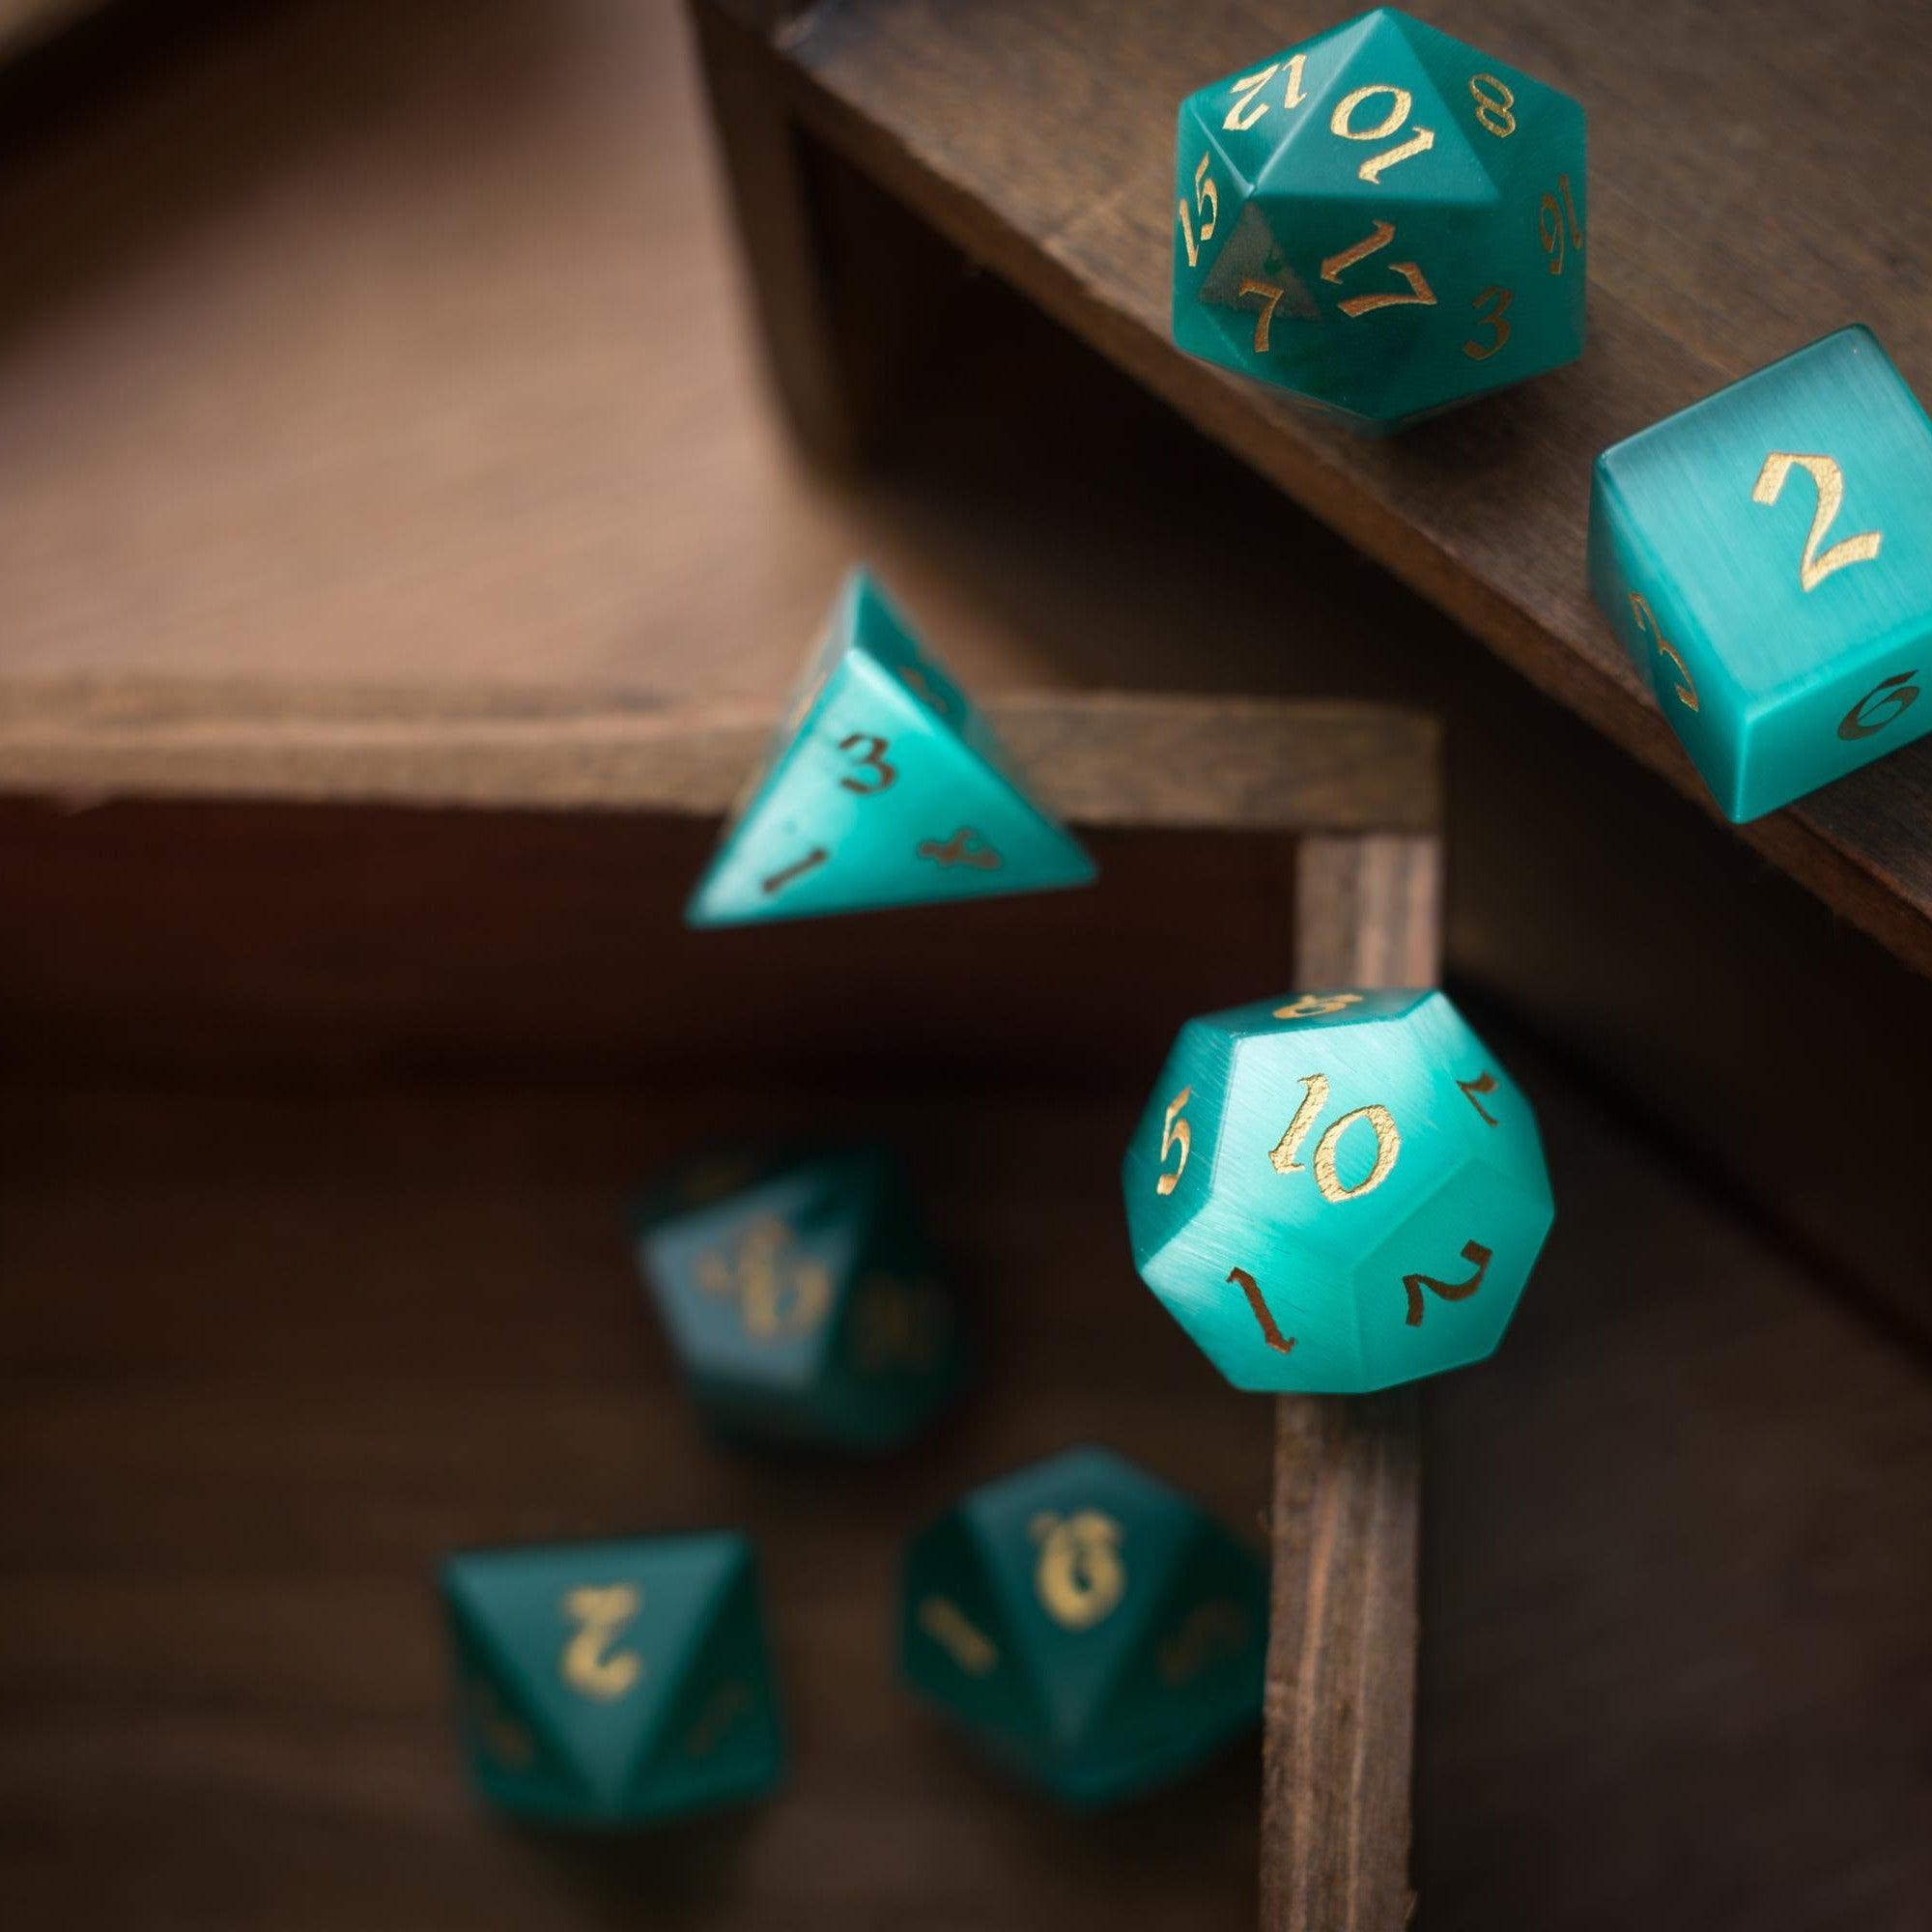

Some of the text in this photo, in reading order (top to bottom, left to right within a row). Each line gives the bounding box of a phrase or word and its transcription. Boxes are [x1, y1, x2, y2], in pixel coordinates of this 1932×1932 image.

[1223, 54, 1307, 130] 12
[1330, 85, 1435, 185] 10
[1468, 72, 1517, 138] 8
[1179, 152, 1218, 268] 15
[1321, 219, 1437, 317] 17
[1239, 279, 1284, 353] 7
[1463, 286, 1513, 360] 3
[1751, 451, 1883, 593] 2
[1629, 591, 1700, 712] 3
[1837, 668, 1920, 741] 6
[838, 733, 898, 795] 3
[1156, 1086, 1193, 1195] 5
[1267, 1072, 1404, 1204] 10
[1226, 1266, 1297, 1354] 1
[1403, 1238, 1493, 1327] 2
